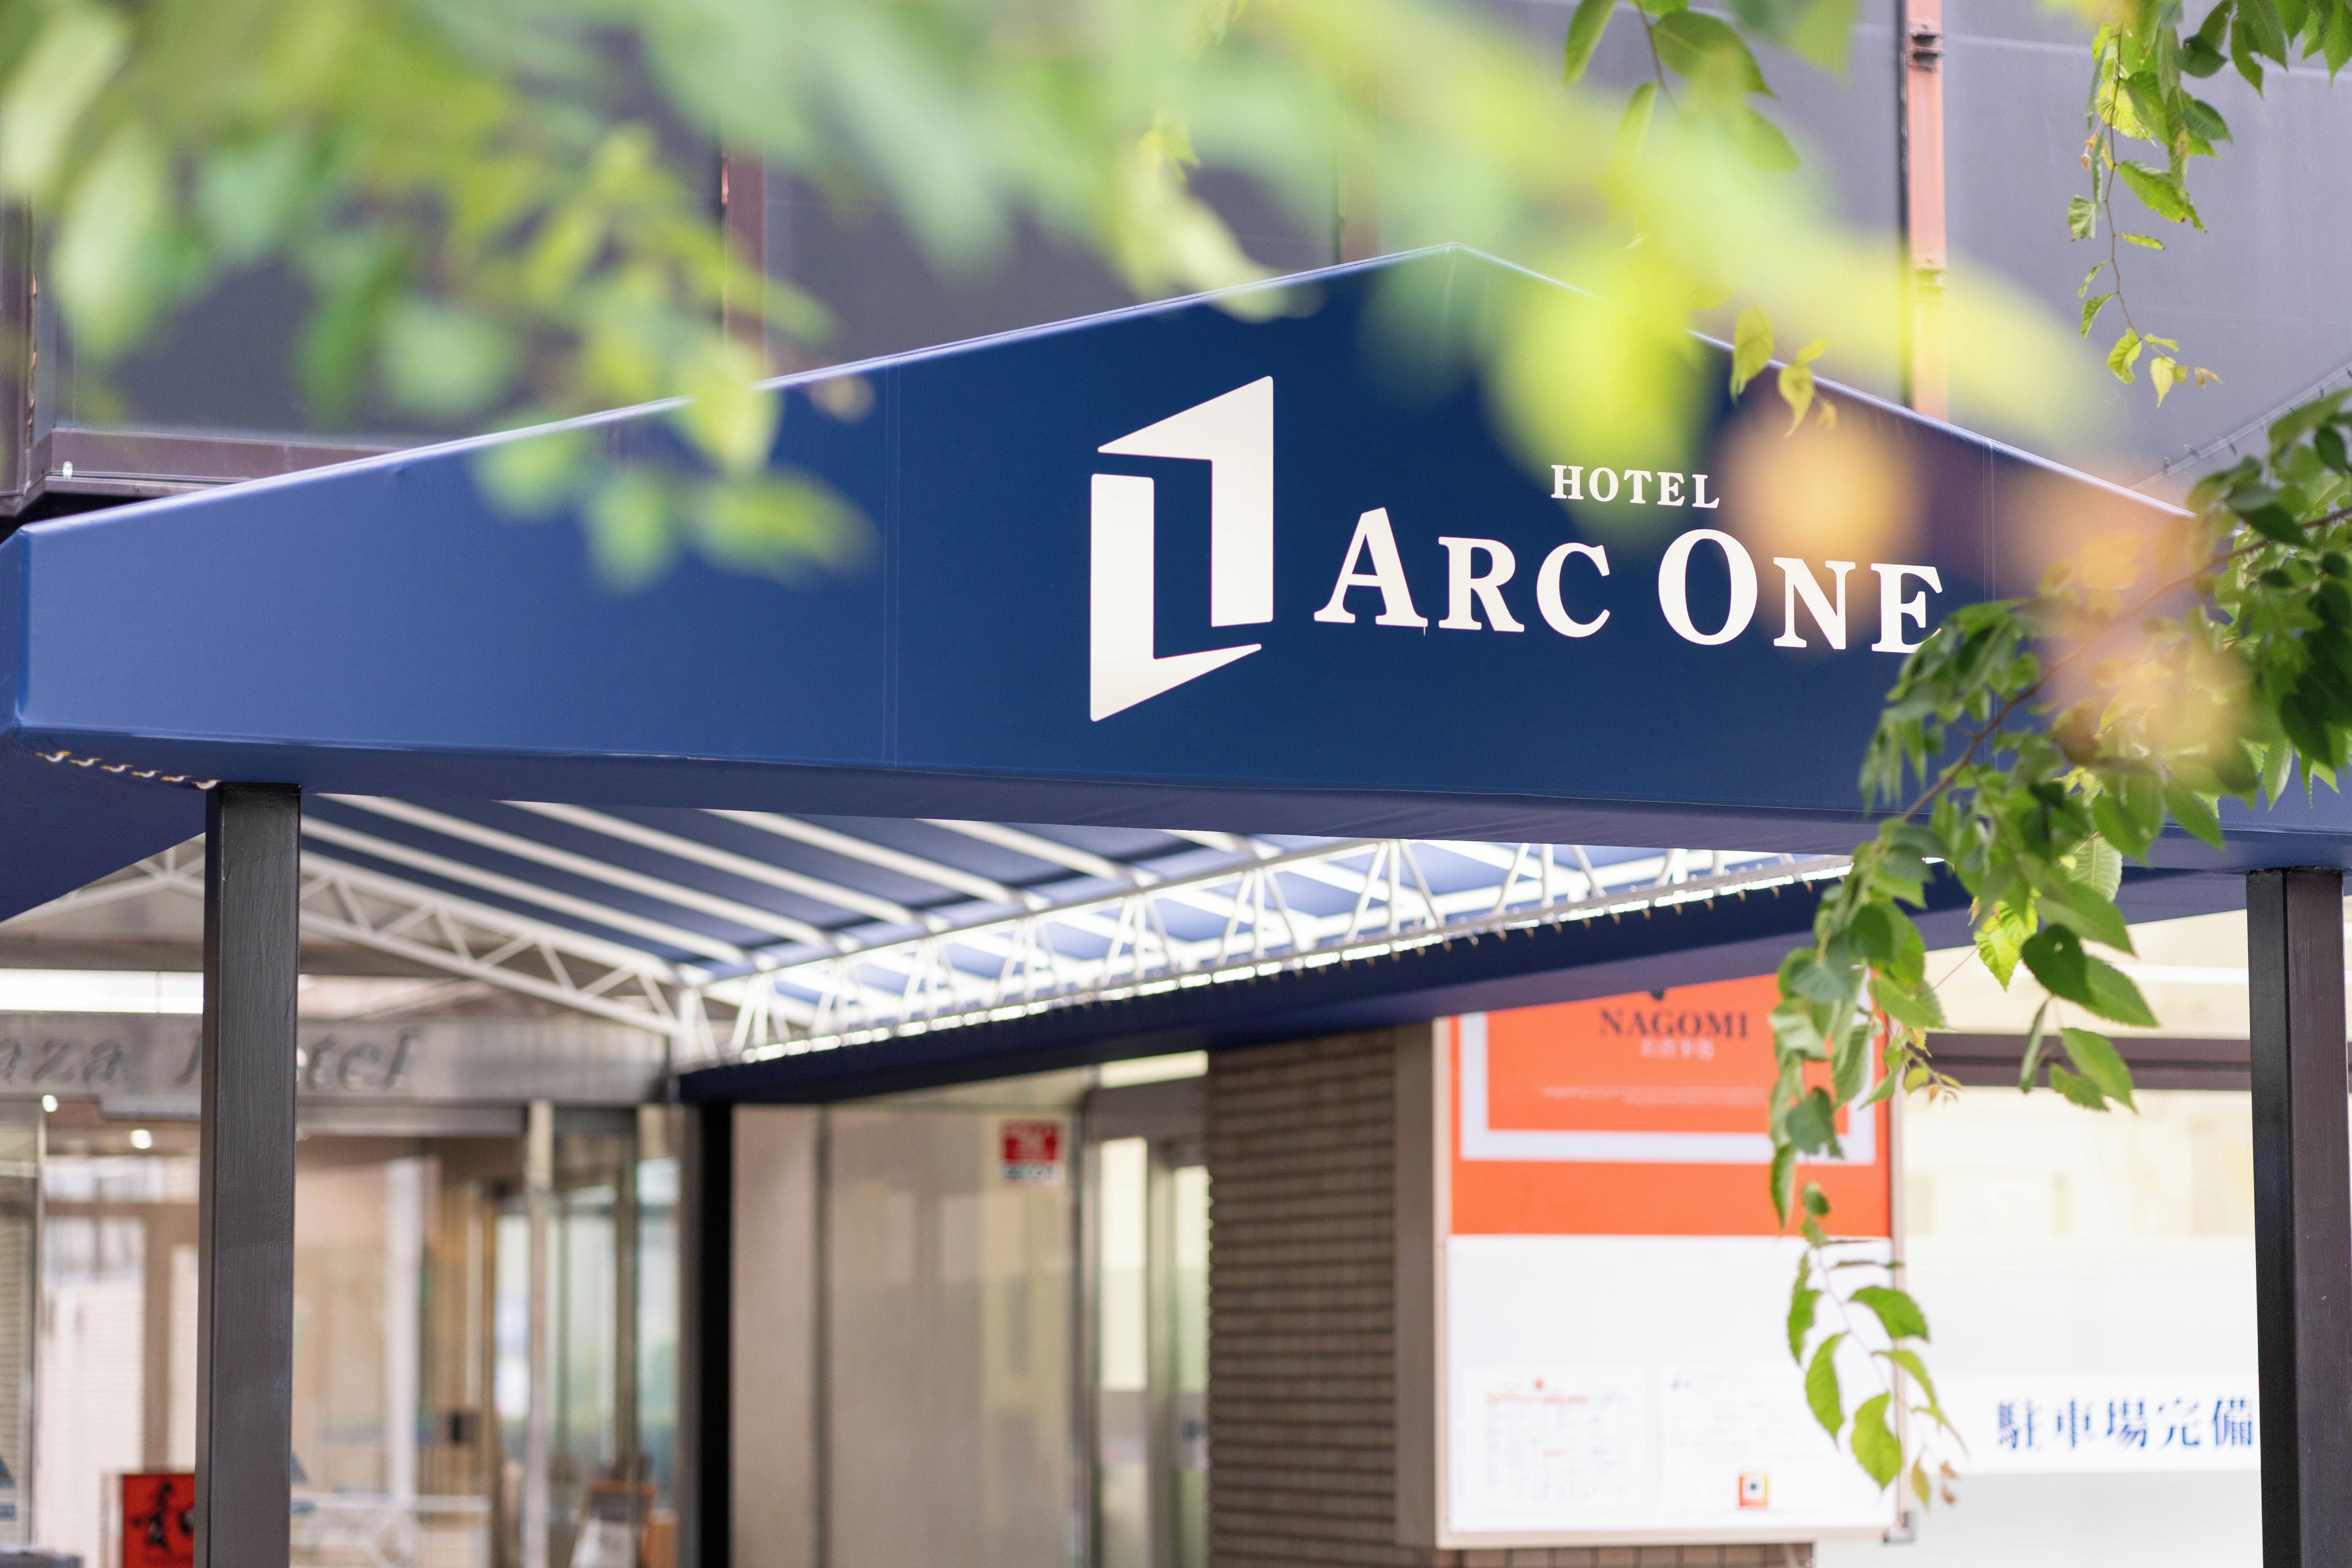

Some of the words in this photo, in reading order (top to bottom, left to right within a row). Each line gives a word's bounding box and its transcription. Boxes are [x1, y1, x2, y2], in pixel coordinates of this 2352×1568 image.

[1550, 464, 1720, 508] HOTEL
[1313, 507, 1611, 638] ARC
[1657, 528, 1943, 654] ONE
[1599, 1008, 1750, 1040] NAGOMI
[1997, 1394, 2254, 1450] 駐車場完備
